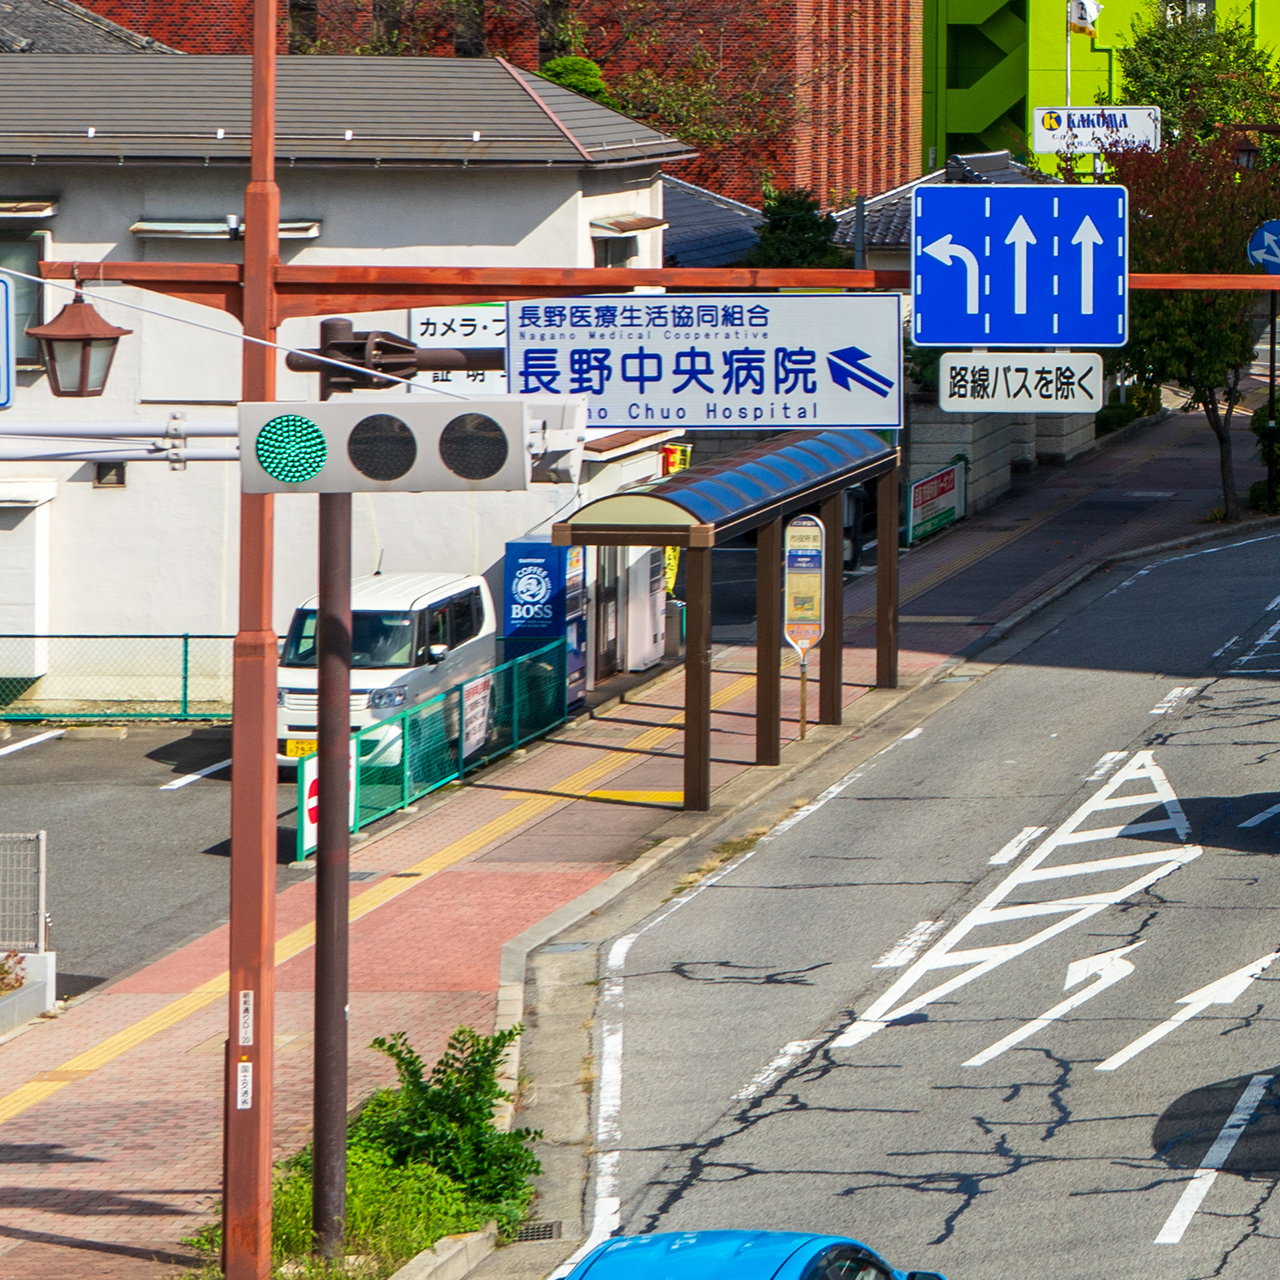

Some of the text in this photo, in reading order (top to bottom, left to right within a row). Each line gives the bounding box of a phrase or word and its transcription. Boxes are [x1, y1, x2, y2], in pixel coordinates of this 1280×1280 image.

[1067, 113, 1128, 129] KAKUMA
[518, 305, 770, 328] 長野医療生活協同組合
[519, 330, 770, 342] Nagano Medical Cooperative
[518, 345, 818, 396] 長野中央病院
[948, 365, 1094, 401] 路線バスを除く
[628, 401, 687, 420] Chuo
[706, 401, 819, 421] Hospital
[515, 566, 549, 579] COFFEE
[511, 604, 553, 619] BOSS
